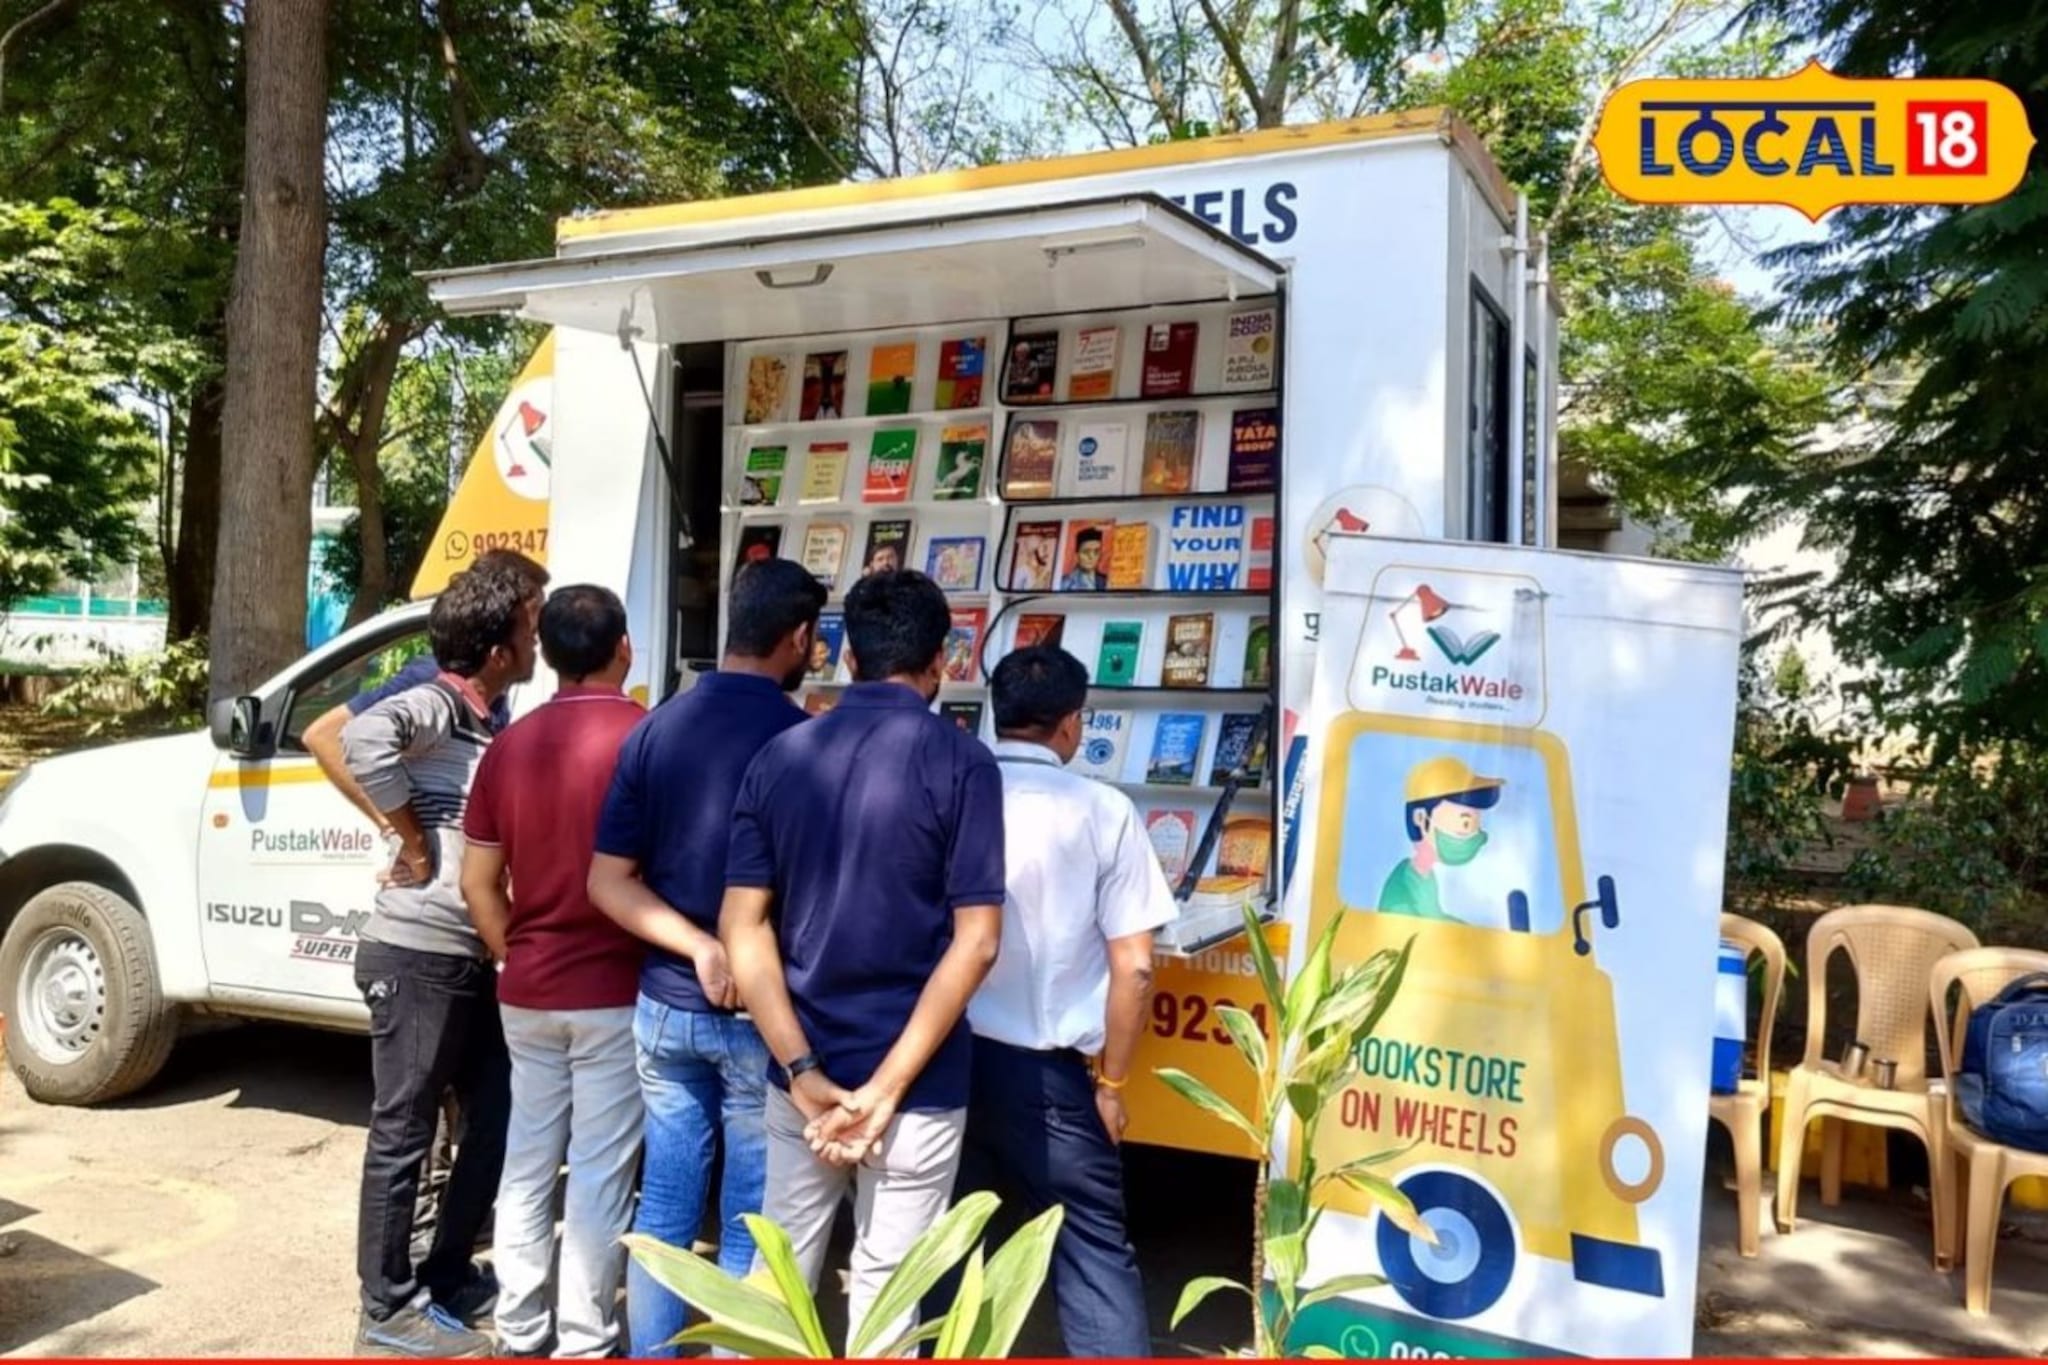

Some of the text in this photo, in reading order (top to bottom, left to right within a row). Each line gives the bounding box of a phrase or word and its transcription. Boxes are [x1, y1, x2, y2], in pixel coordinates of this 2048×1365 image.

[1170, 181, 1298, 245] ELS
[1230, 313, 1272, 326] INDIA
[1230, 323, 1272, 338] 2020
[1226, 372, 1270, 384] KALAM
[1234, 425, 1278, 441] TATA
[1172, 504, 1244, 528] FIND
[1171, 537, 1240, 551] YOUR
[1167, 562, 1239, 591] WHY
[1371, 665, 1524, 700] PustakWale
[251, 828, 372, 851] PustakWale
[207, 902, 283, 928] ISUZU
[292, 939, 353, 960] SUPER
[1340, 1087, 1518, 1158] ON WHEELS
